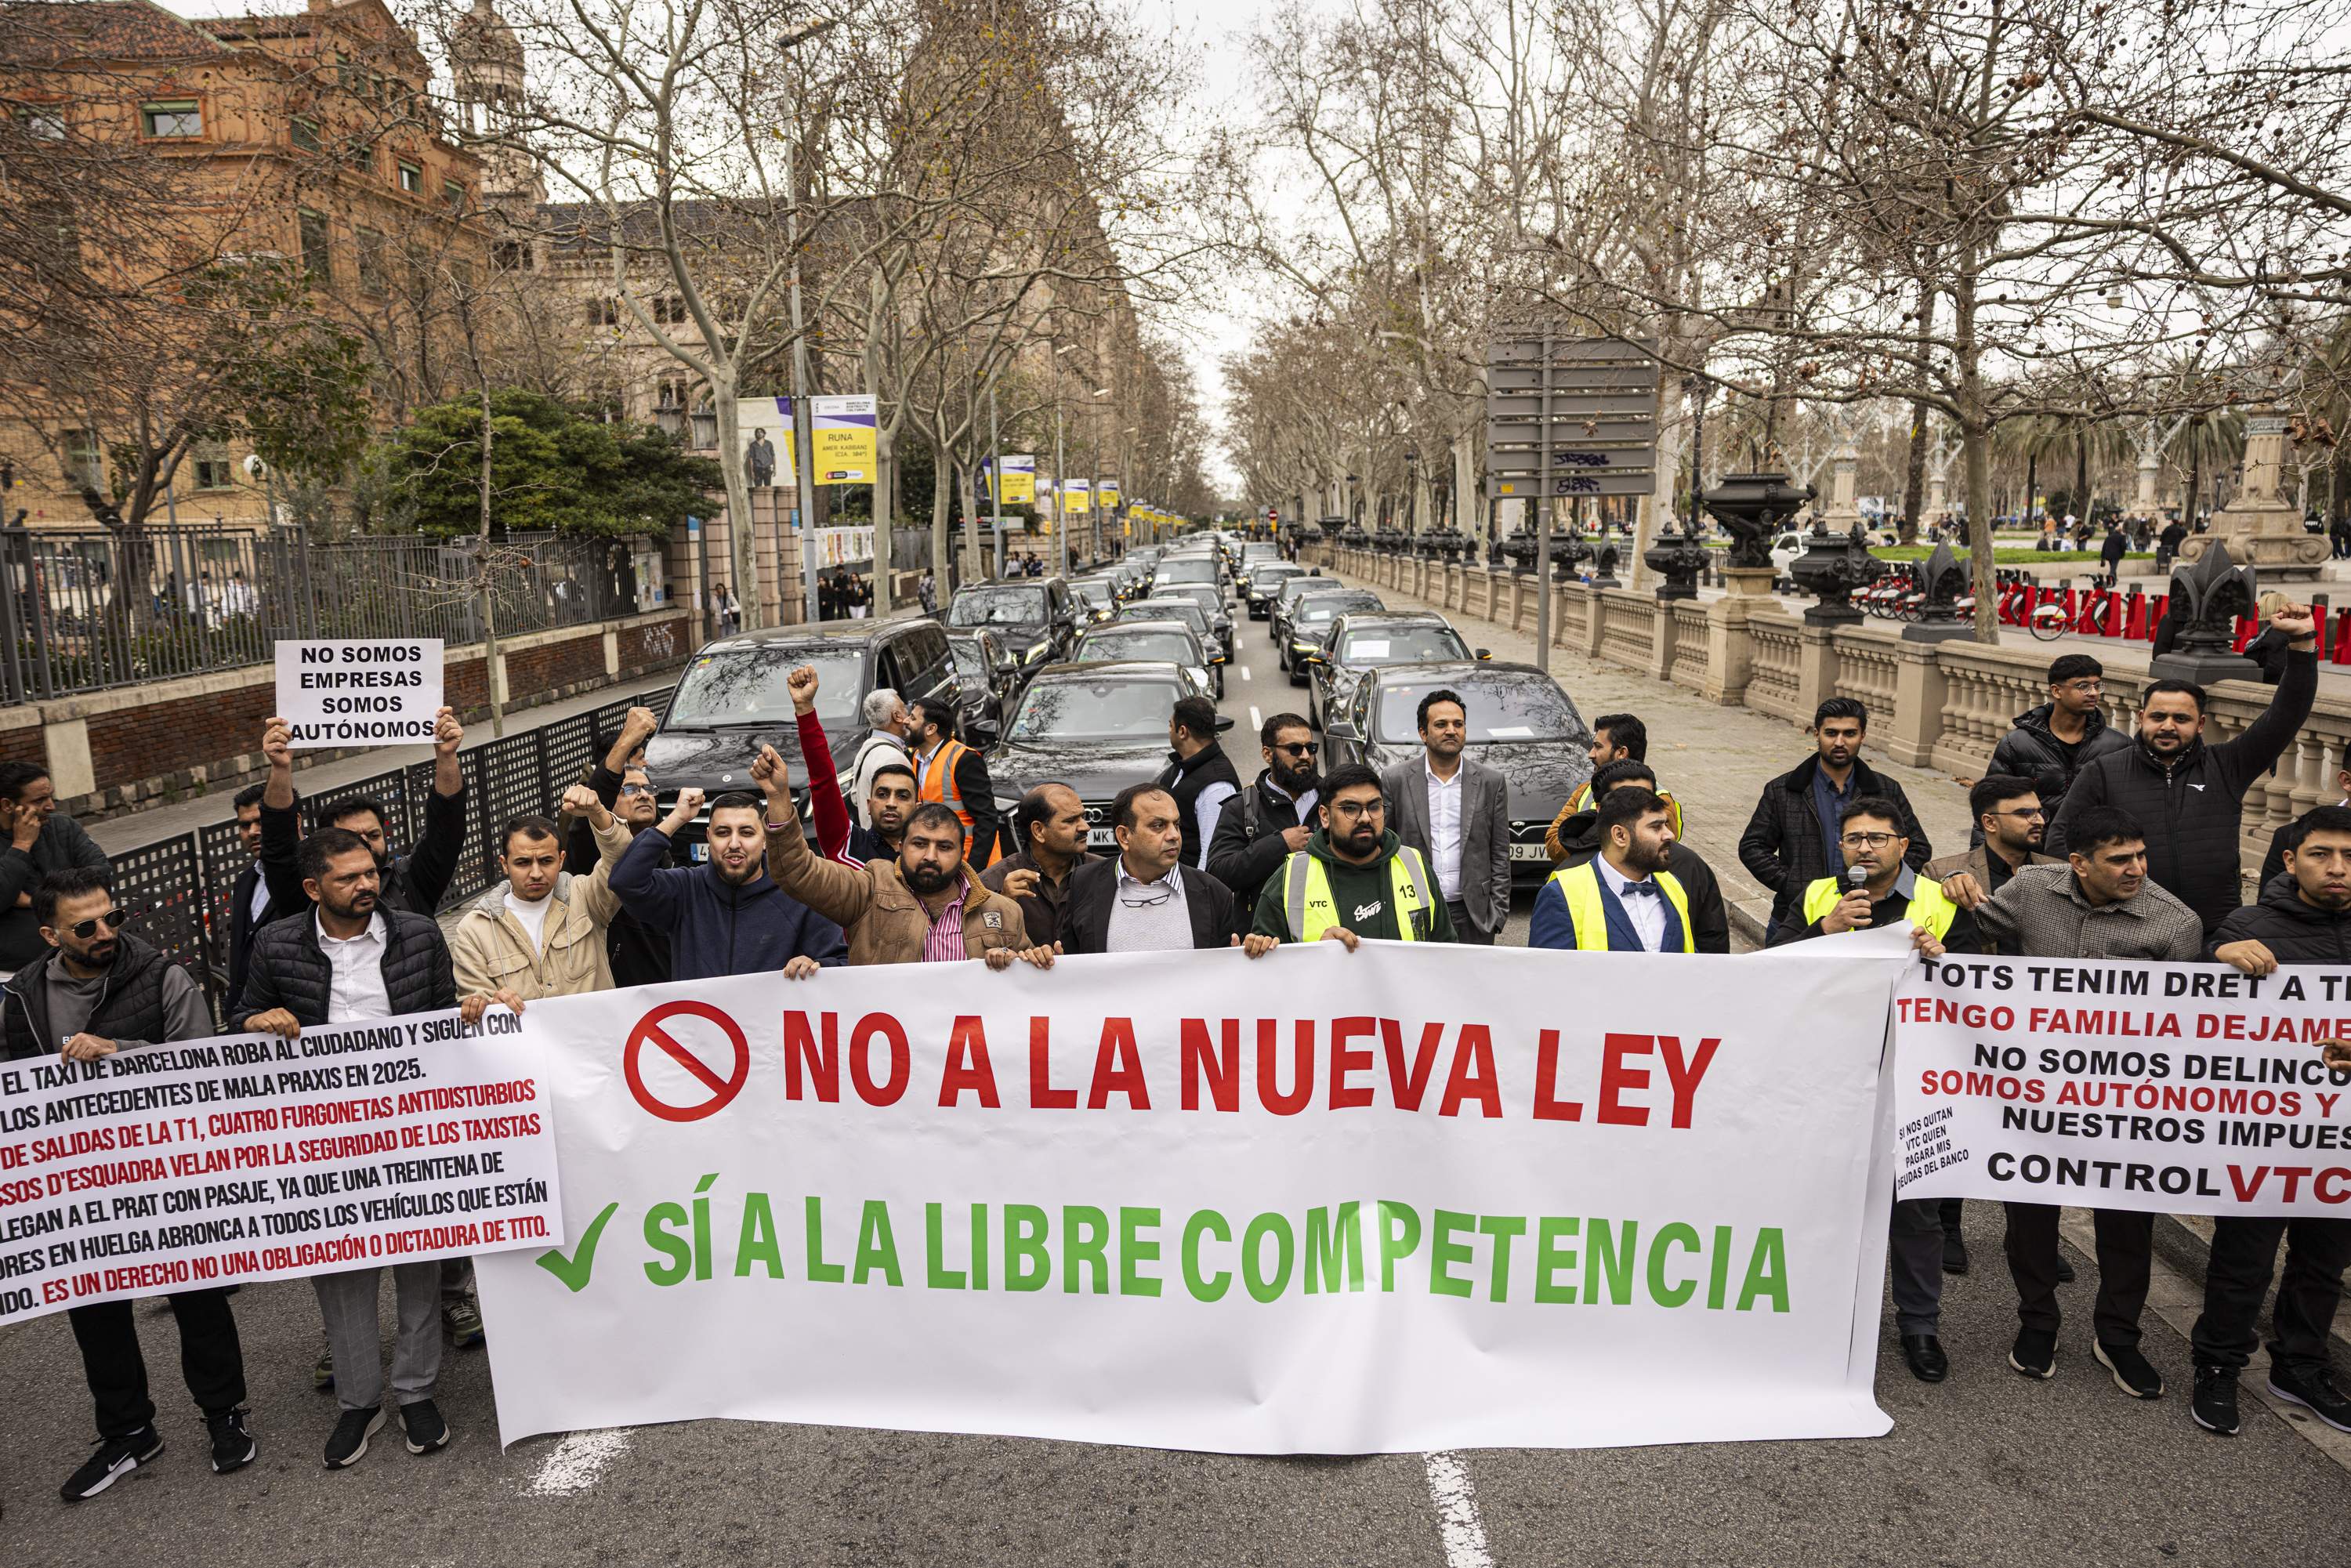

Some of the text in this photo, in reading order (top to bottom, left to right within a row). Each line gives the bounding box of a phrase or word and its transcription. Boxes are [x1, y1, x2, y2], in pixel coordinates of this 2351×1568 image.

[301, 646, 422, 664] NO SOMOS
[301, 671, 422, 689] EMPRESAS
[322, 696, 403, 714] SOMOS
[291, 719, 434, 741] AUTÓNOMOS
[1400, 884, 1416, 899] 13
[1920, 957, 2013, 991] TOTS
[2027, 966, 2149, 996] TENIM
[2164, 972, 2266, 999] DRET
[2279, 976, 2306, 1001] A
[1896, 998, 2351, 1043] TENGO FAMILIA DEJAME
[2, 1012, 522, 1095] EL TAXI DE BARCELONA ROBA AL CIUDADANO Y SIGUEN CON
[784, 1010, 1722, 1129] NO A LA NUEVA LEY
[1974, 1044, 2027, 1072] NO
[2039, 1048, 2170, 1079] SOMOS
[0, 1058, 426, 1133] LOS ANTECEDENTES DE MALA PRAXIS EN 2025.
[1921, 1070, 2342, 1118] SOMOS AUTÓNOMOS Y
[0, 1078, 536, 1170] DE SALIDAS DE LA T1, CUATRO FURGONETAS ANTIDISTURBIOS
[1900, 1106, 1953, 1140] SI NOS QUITAN
[1906, 1124, 1947, 1151] VTC QUIEN
[2002, 1106, 2204, 1144] NUESTROS
[46, 1157, 168, 1196] D'ESQUADRA
[169, 1149, 231, 1177] VELAN
[234, 1145, 270, 1169] POR
[273, 1142, 296, 1165] LA
[298, 1129, 397, 1163] SEGURIDAD
[400, 1125, 425, 1149] DE
[427, 1121, 460, 1146] LOS
[462, 1113, 541, 1141] TAXISTAS
[1897, 1149, 1969, 1191] DEUDAS DEL BANCO
[1906, 1139, 1951, 1168] PAGARA MIS
[69, 1204, 83, 1228] A
[85, 1200, 110, 1224] EL
[112, 1193, 158, 1220] PRAT
[162, 1188, 202, 1214] CON
[205, 1180, 275, 1208] PASAJE,
[277, 1176, 302, 1199] YA
[303, 1171, 340, 1197] QUE
[342, 1166, 382, 1191] UNA
[382, 1154, 479, 1185] TREINTENA
[481, 1151, 504, 1174] DE
[1987, 1151, 2351, 1206] CONTROL VTC
[48, 1240, 77, 1268] EN
[80, 1230, 154, 1261] HUELGA
[158, 1218, 245, 1251] ABRONCA
[248, 1216, 260, 1238] A
[262, 1208, 321, 1237] TODOS
[324, 1203, 358, 1229] LOS
[360, 1192, 455, 1223] VEHÍCULOS
[457, 1186, 492, 1213] QUE
[494, 1178, 548, 1207] ESTÁN
[643, 1172, 1791, 1313] SÍ A LA LIBRE COMPETENCIA
[42, 1278, 70, 1305] ES
[72, 1271, 102, 1297] UN
[104, 1260, 188, 1292] DERECHO
[192, 1256, 218, 1280] NO
[221, 1250, 260, 1276] UNA
[263, 1233, 367, 1271] OBLIGACIÓN
[369, 1234, 382, 1257] O
[385, 1223, 480, 1255] DICTADURA
[483, 1220, 505, 1244] DE
[508, 1215, 550, 1240] TITO.
